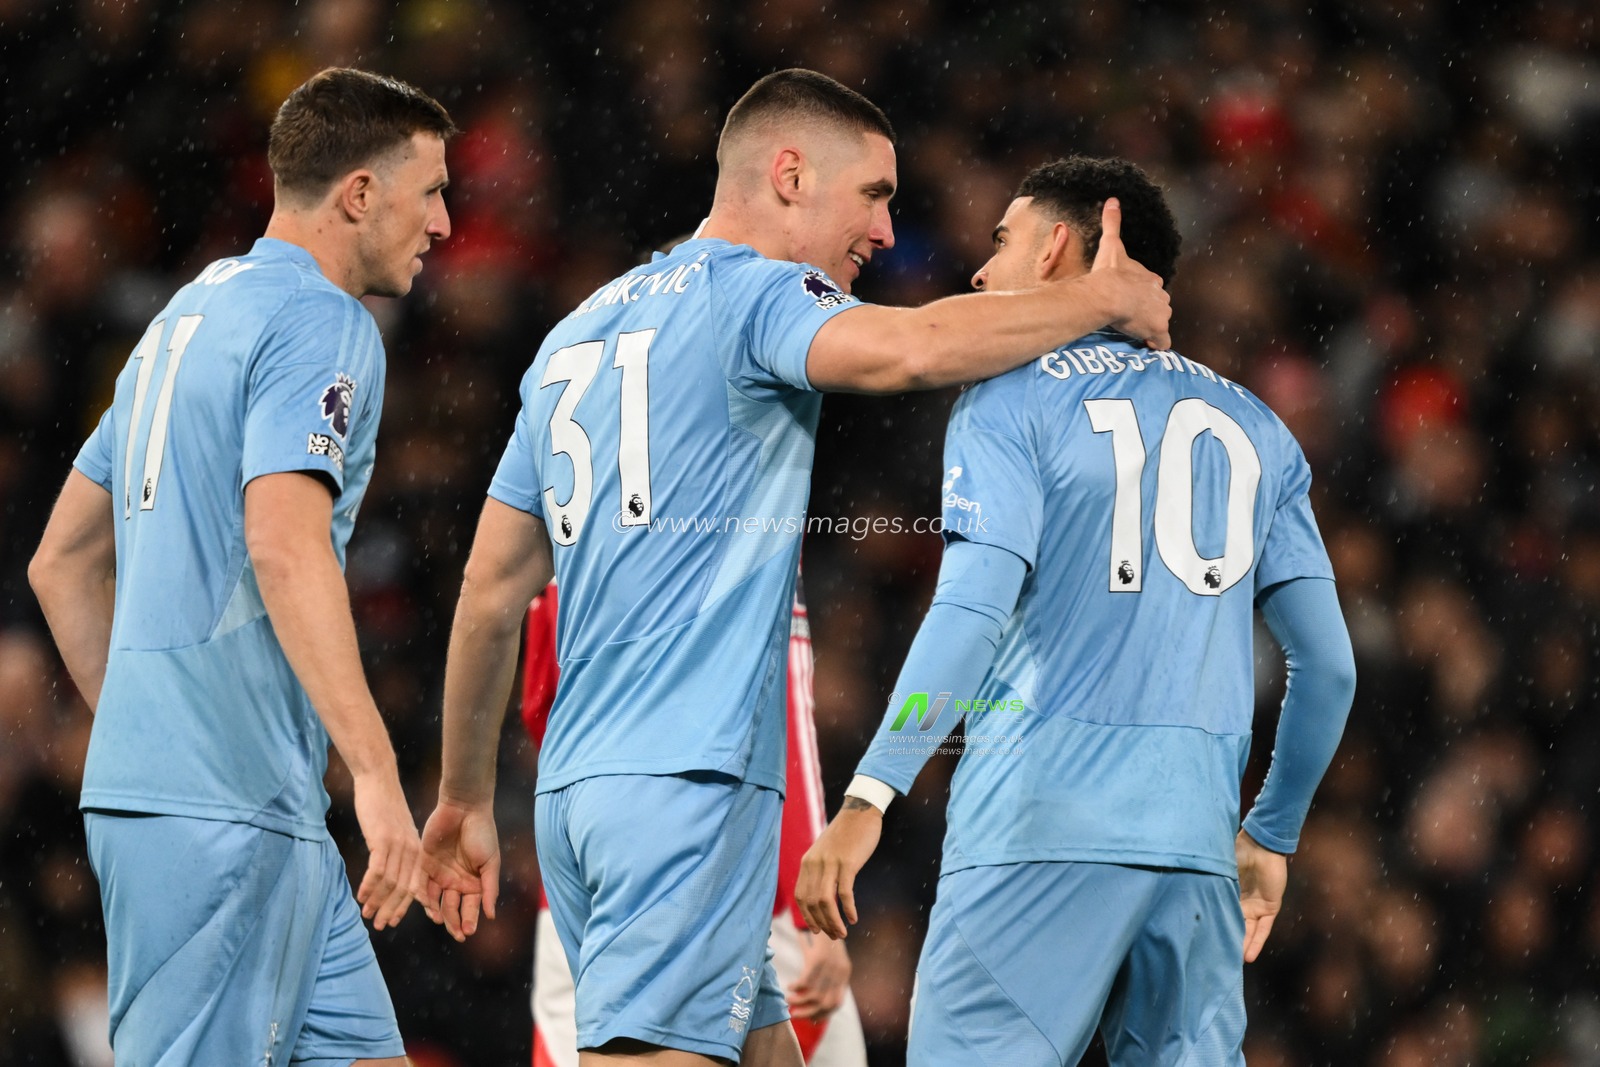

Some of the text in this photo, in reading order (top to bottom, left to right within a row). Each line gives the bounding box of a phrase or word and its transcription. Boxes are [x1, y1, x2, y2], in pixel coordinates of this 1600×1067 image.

[124, 314, 204, 521] 11
[308, 432, 330, 446] No
[540, 328, 657, 546] 31
[1083, 397, 1262, 596] 10
